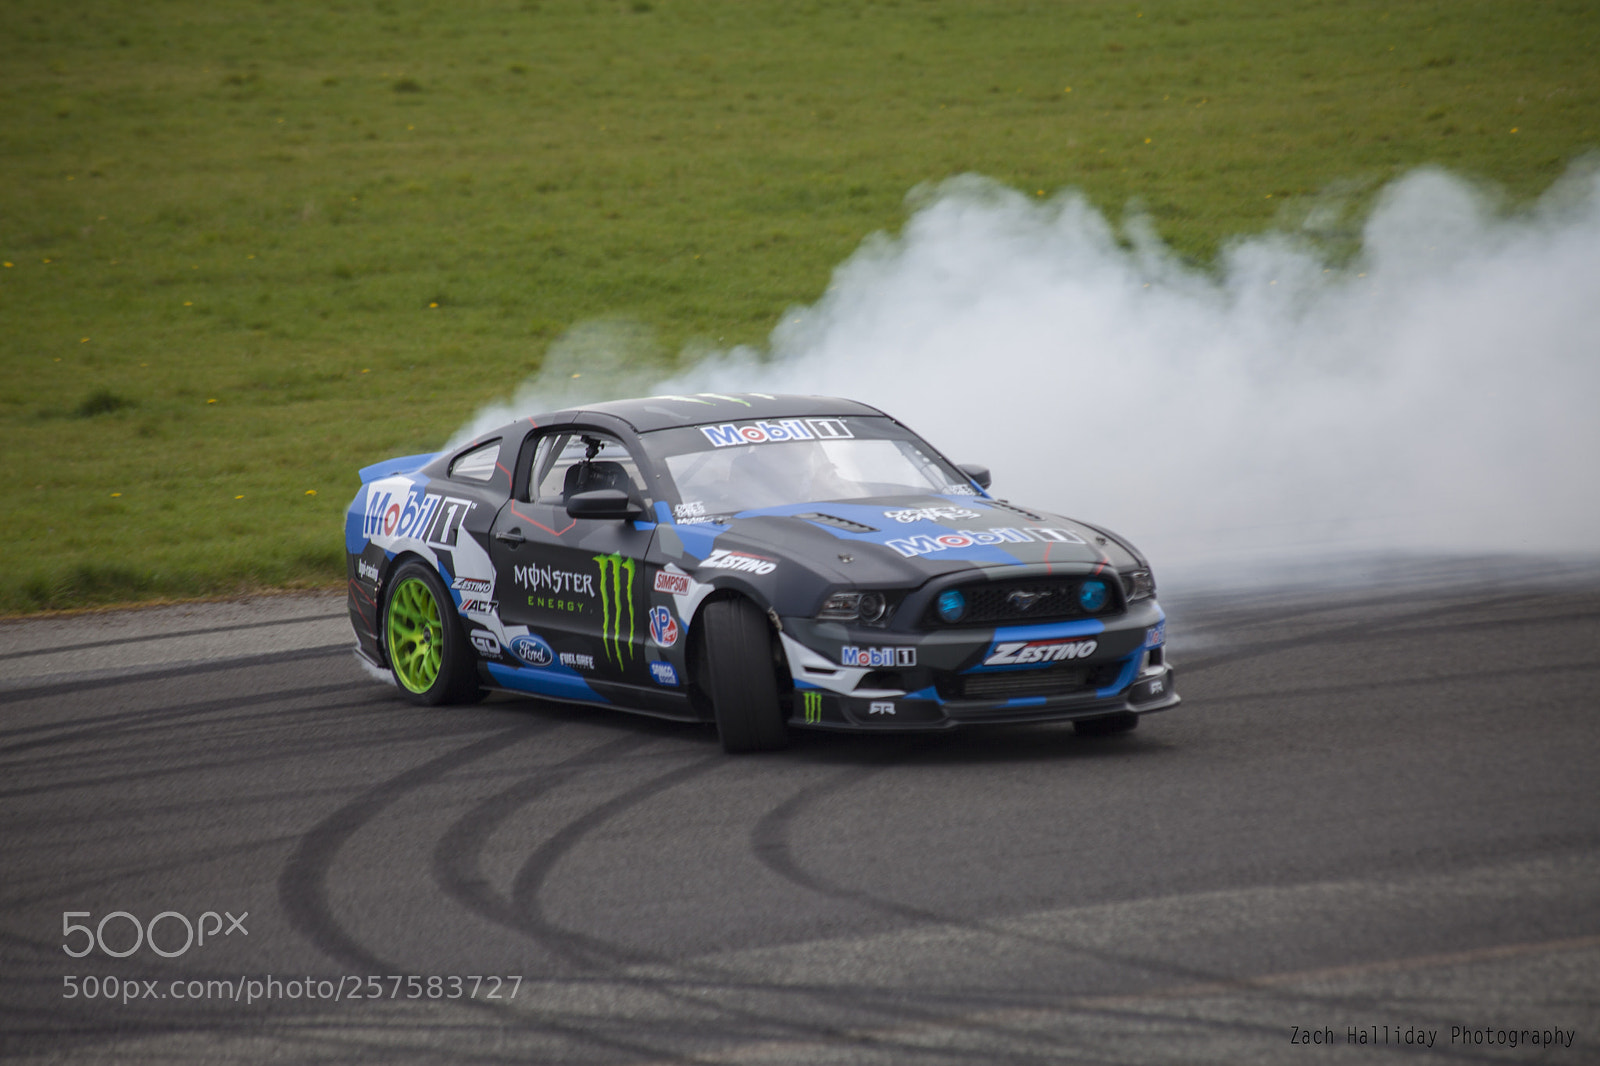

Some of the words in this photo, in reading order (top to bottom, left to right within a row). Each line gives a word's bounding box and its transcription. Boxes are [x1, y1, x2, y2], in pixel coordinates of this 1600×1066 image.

[703, 420, 813, 446] Mobil
[363, 491, 439, 540] Mobil
[886, 528, 1035, 557] Mobil
[698, 549, 777, 575] ZESTINO
[451, 577, 491, 594] ZESTINO
[514, 563, 596, 598] MONSTER
[656, 574, 690, 592] SIMPSON
[527, 595, 584, 612] ENERGY
[649, 606, 671, 643] VP
[519, 640, 546, 662] Ford
[842, 646, 894, 666] Mobil
[984, 640, 1098, 666] ZESTINO
